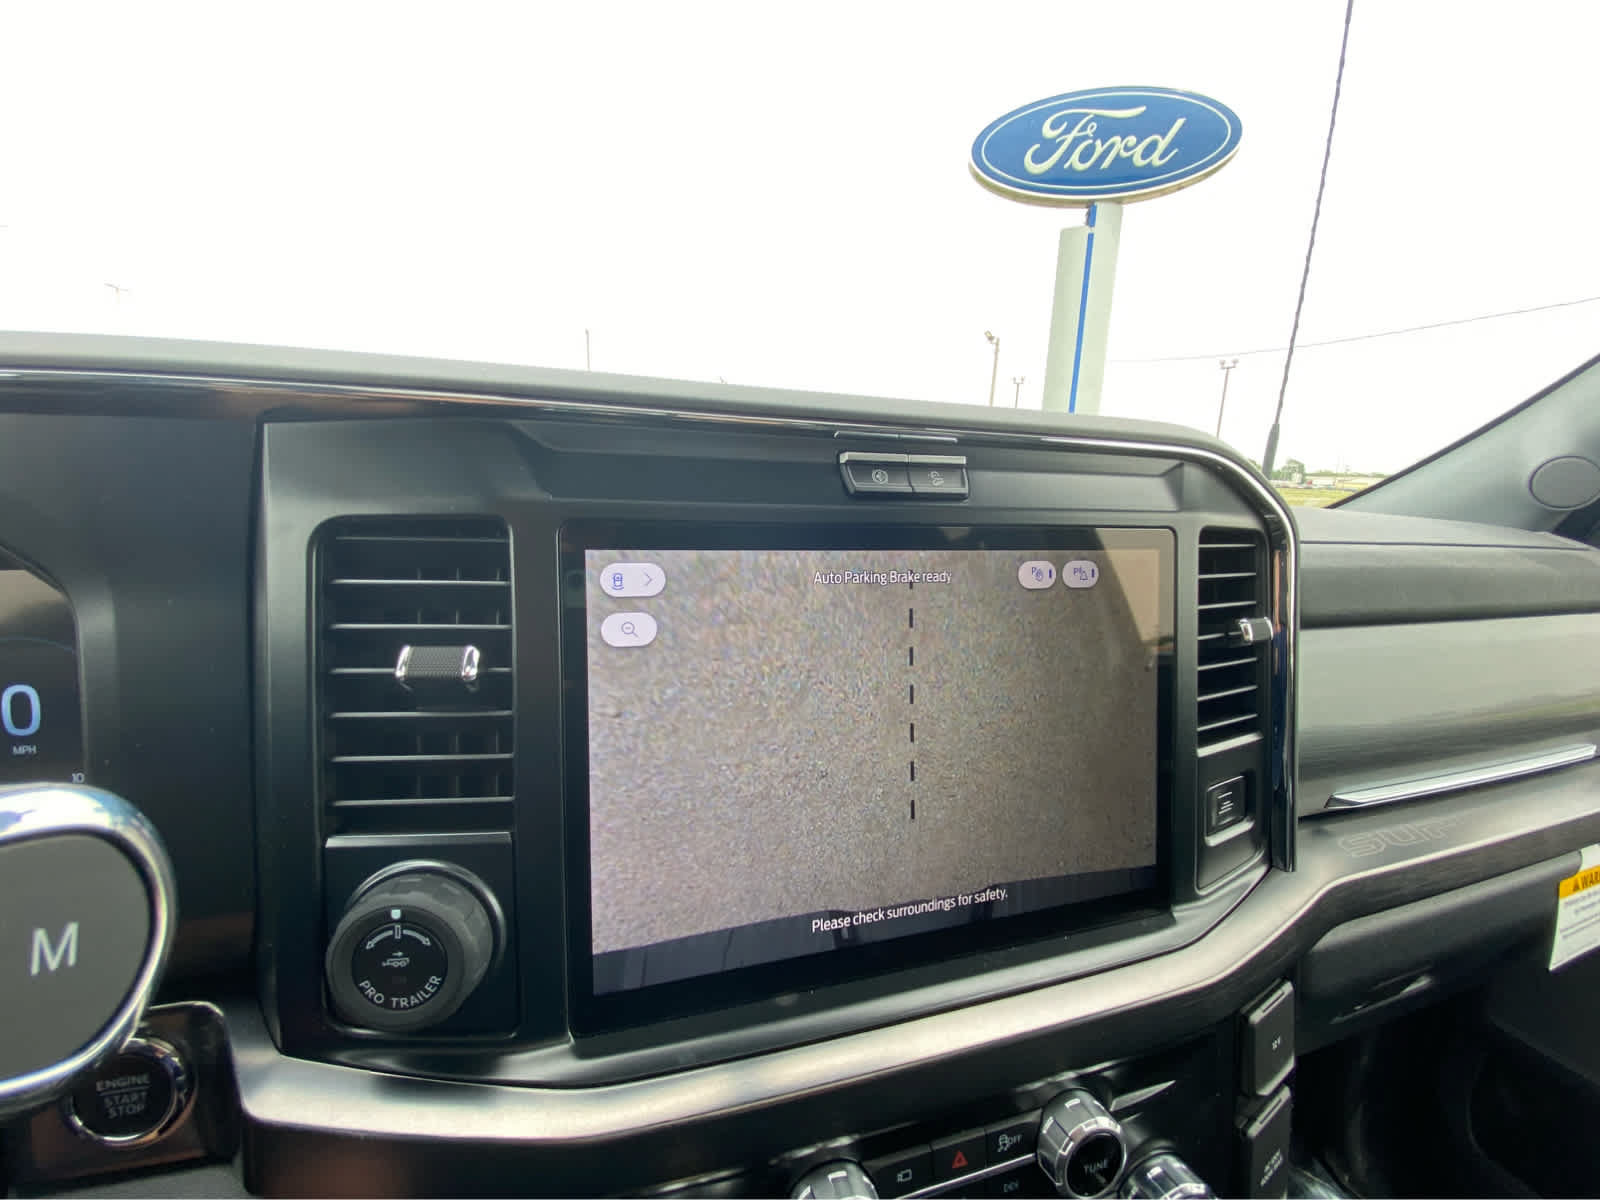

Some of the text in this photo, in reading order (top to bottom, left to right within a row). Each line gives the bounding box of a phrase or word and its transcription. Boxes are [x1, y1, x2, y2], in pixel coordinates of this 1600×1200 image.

[1024, 105, 1187, 174] Ford
[813, 570, 952, 586] Auto Parking Brake ready
[2, 684, 41, 736] 0
[13, 745, 37, 755] MPH
[72, 772, 85, 784] 10
[812, 888, 1009, 933] Please check surroundings for safety.
[30, 922, 79, 976] M
[359, 975, 442, 1009] PRO TRAILER
[96, 1073, 150, 1092] ENGINE
[103, 1091, 147, 1108] START
[107, 1103, 145, 1119] STOP
